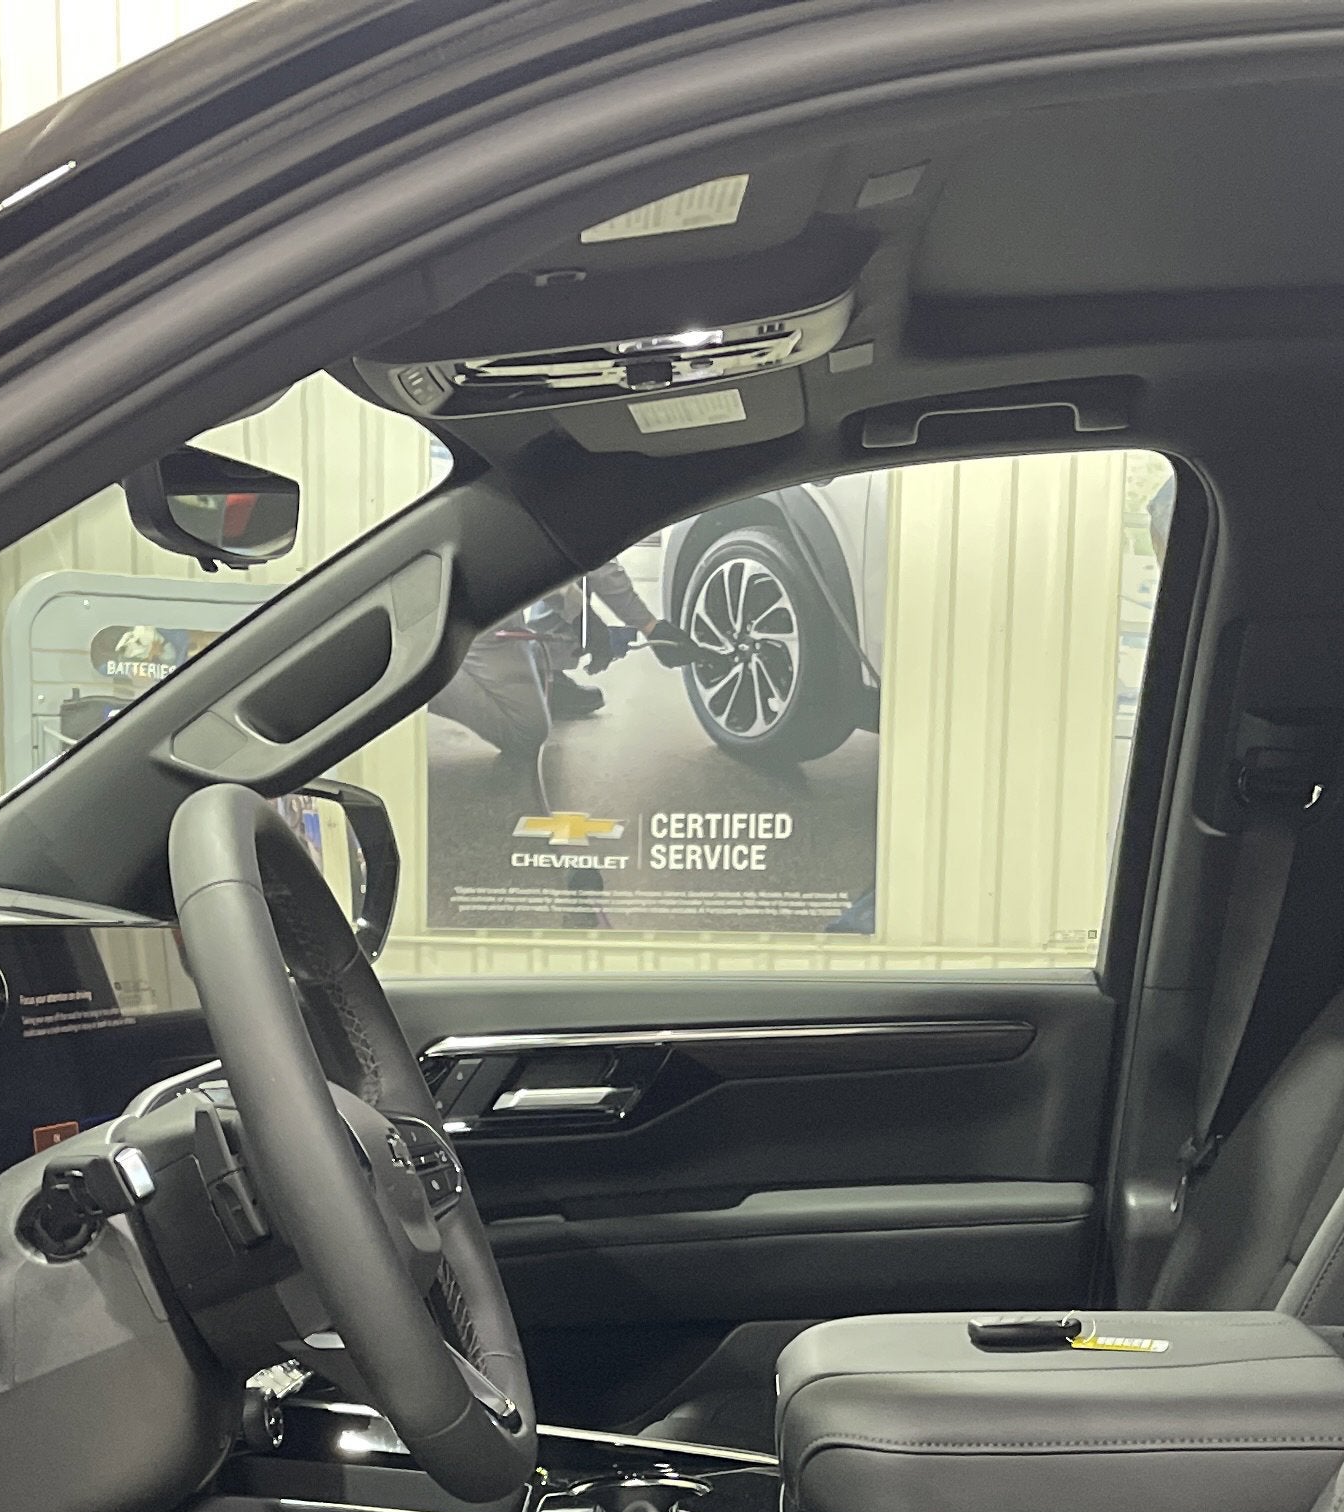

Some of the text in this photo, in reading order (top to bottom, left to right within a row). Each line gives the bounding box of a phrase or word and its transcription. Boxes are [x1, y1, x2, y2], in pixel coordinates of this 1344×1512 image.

[649, 811, 793, 841] CERTIFIED
[511, 852, 630, 870] CHEVROLET
[649, 844, 768, 872] SERVICE
